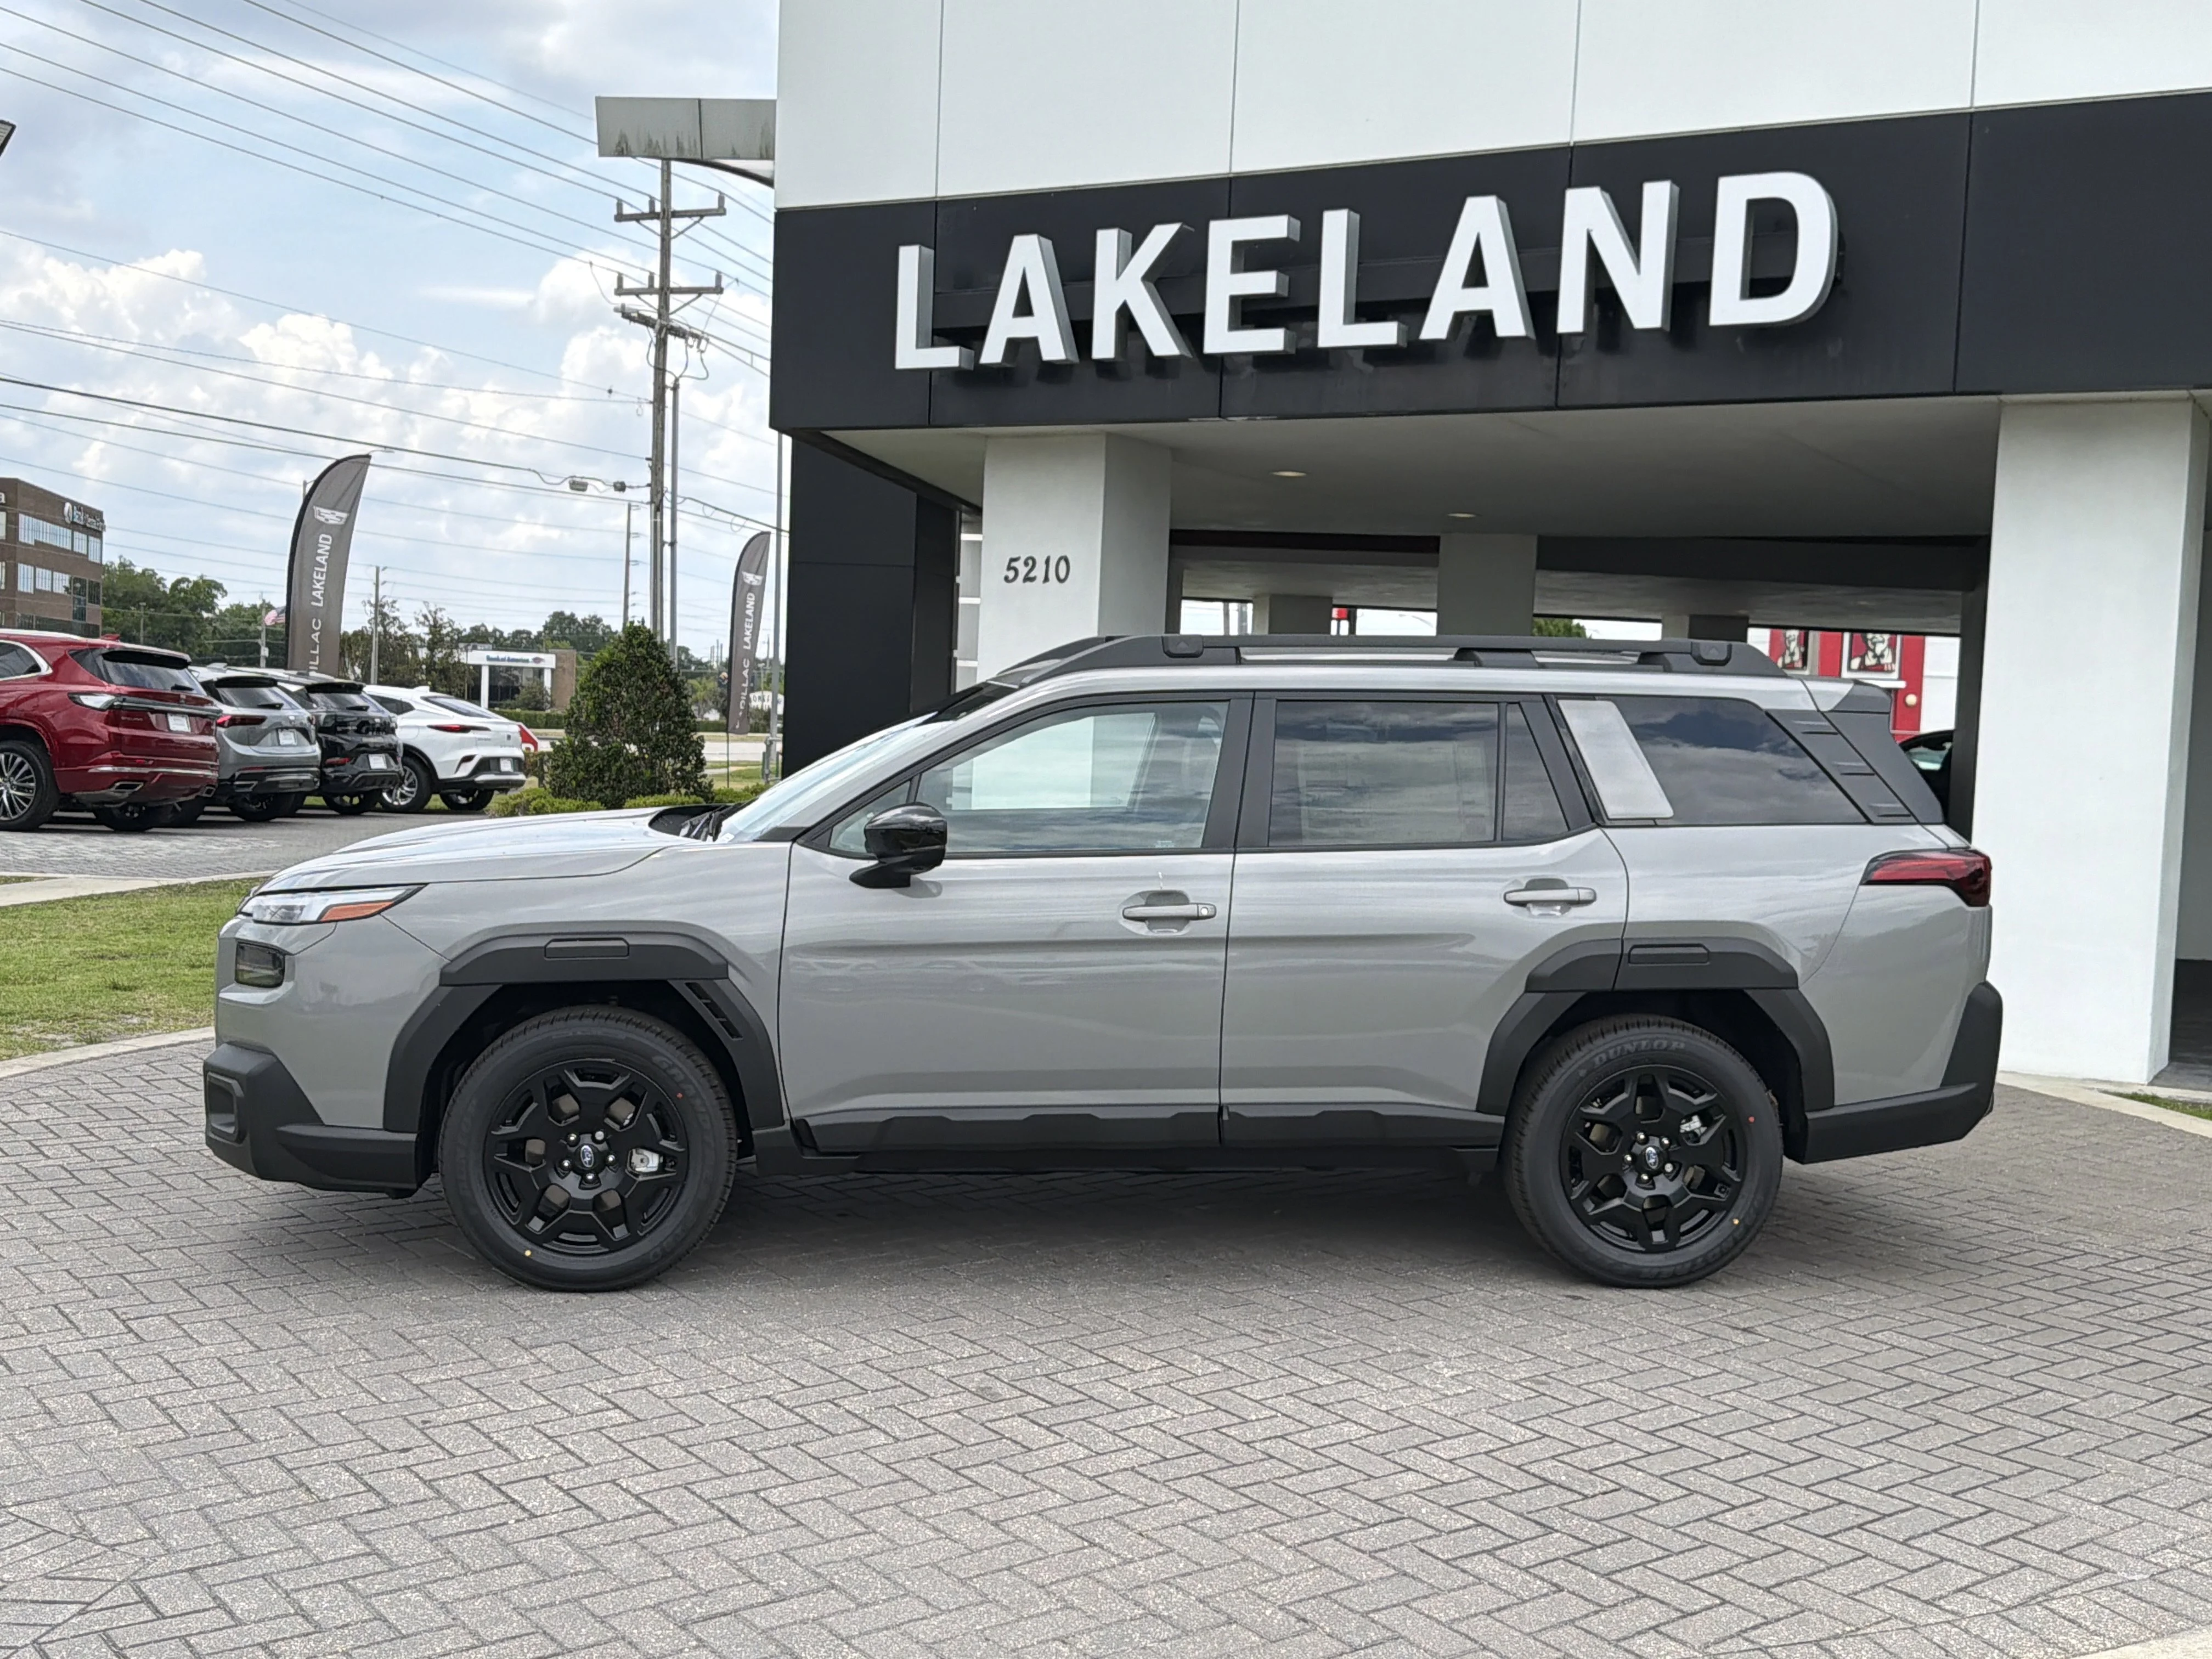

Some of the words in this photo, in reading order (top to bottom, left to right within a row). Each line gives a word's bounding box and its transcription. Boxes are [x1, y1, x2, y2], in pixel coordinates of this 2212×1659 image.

[896, 171, 1838, 371] LAKELAND
[311, 533, 332, 607] LAKELAND
[1003, 555, 1071, 584] 5210
[308, 618, 321, 671] ILLAC
[743, 592, 755, 650] LAKELAND
[1594, 1040, 1685, 1065] DUNLOP
